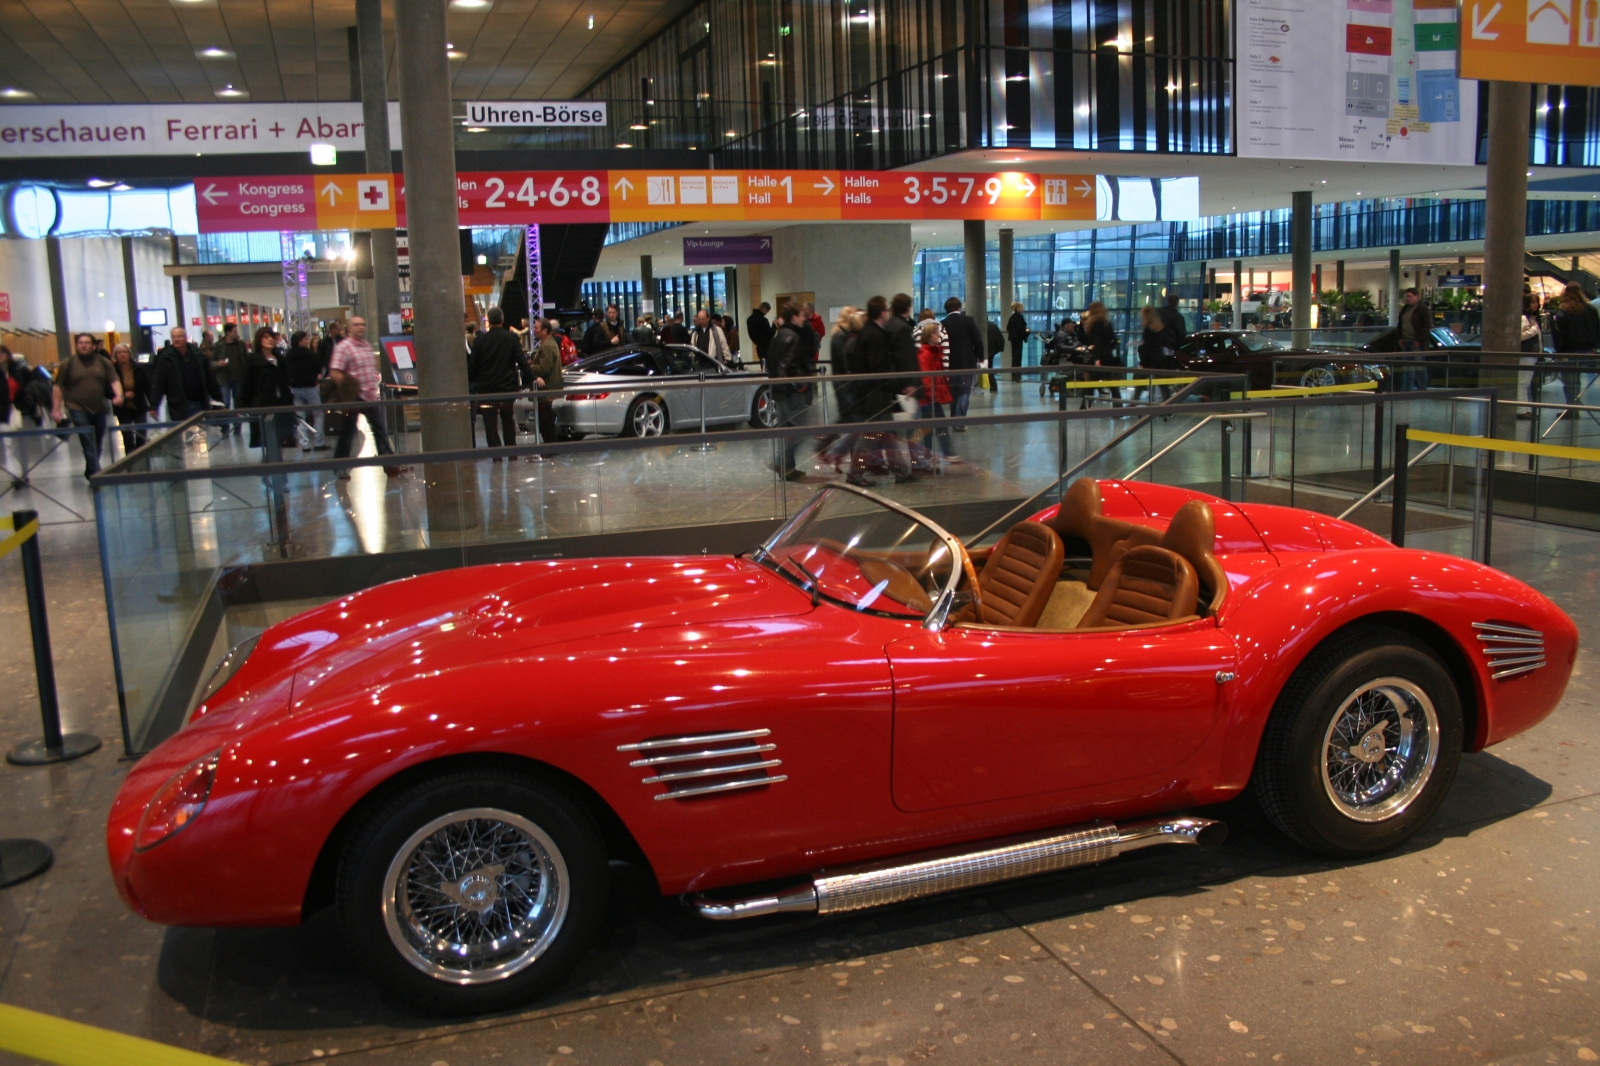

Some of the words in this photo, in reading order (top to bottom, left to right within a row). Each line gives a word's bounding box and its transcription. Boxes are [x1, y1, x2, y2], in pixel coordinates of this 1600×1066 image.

[471, 105, 603, 123] Uhren-Börse
[1, 118, 147, 143] erschauen
[167, 118, 258, 141] Ferrari
[296, 116, 365, 139] Abar
[457, 178, 477, 190] len
[844, 176, 879, 187] Hallen
[238, 182, 304, 198] Kongress
[748, 175, 778, 187] Halle
[779, 175, 793, 204] 1
[748, 192, 771, 204] Hall
[845, 192, 872, 204] Halls
[240, 201, 306, 217] Congress
[686, 239, 724, 249] Vip-Lounge
